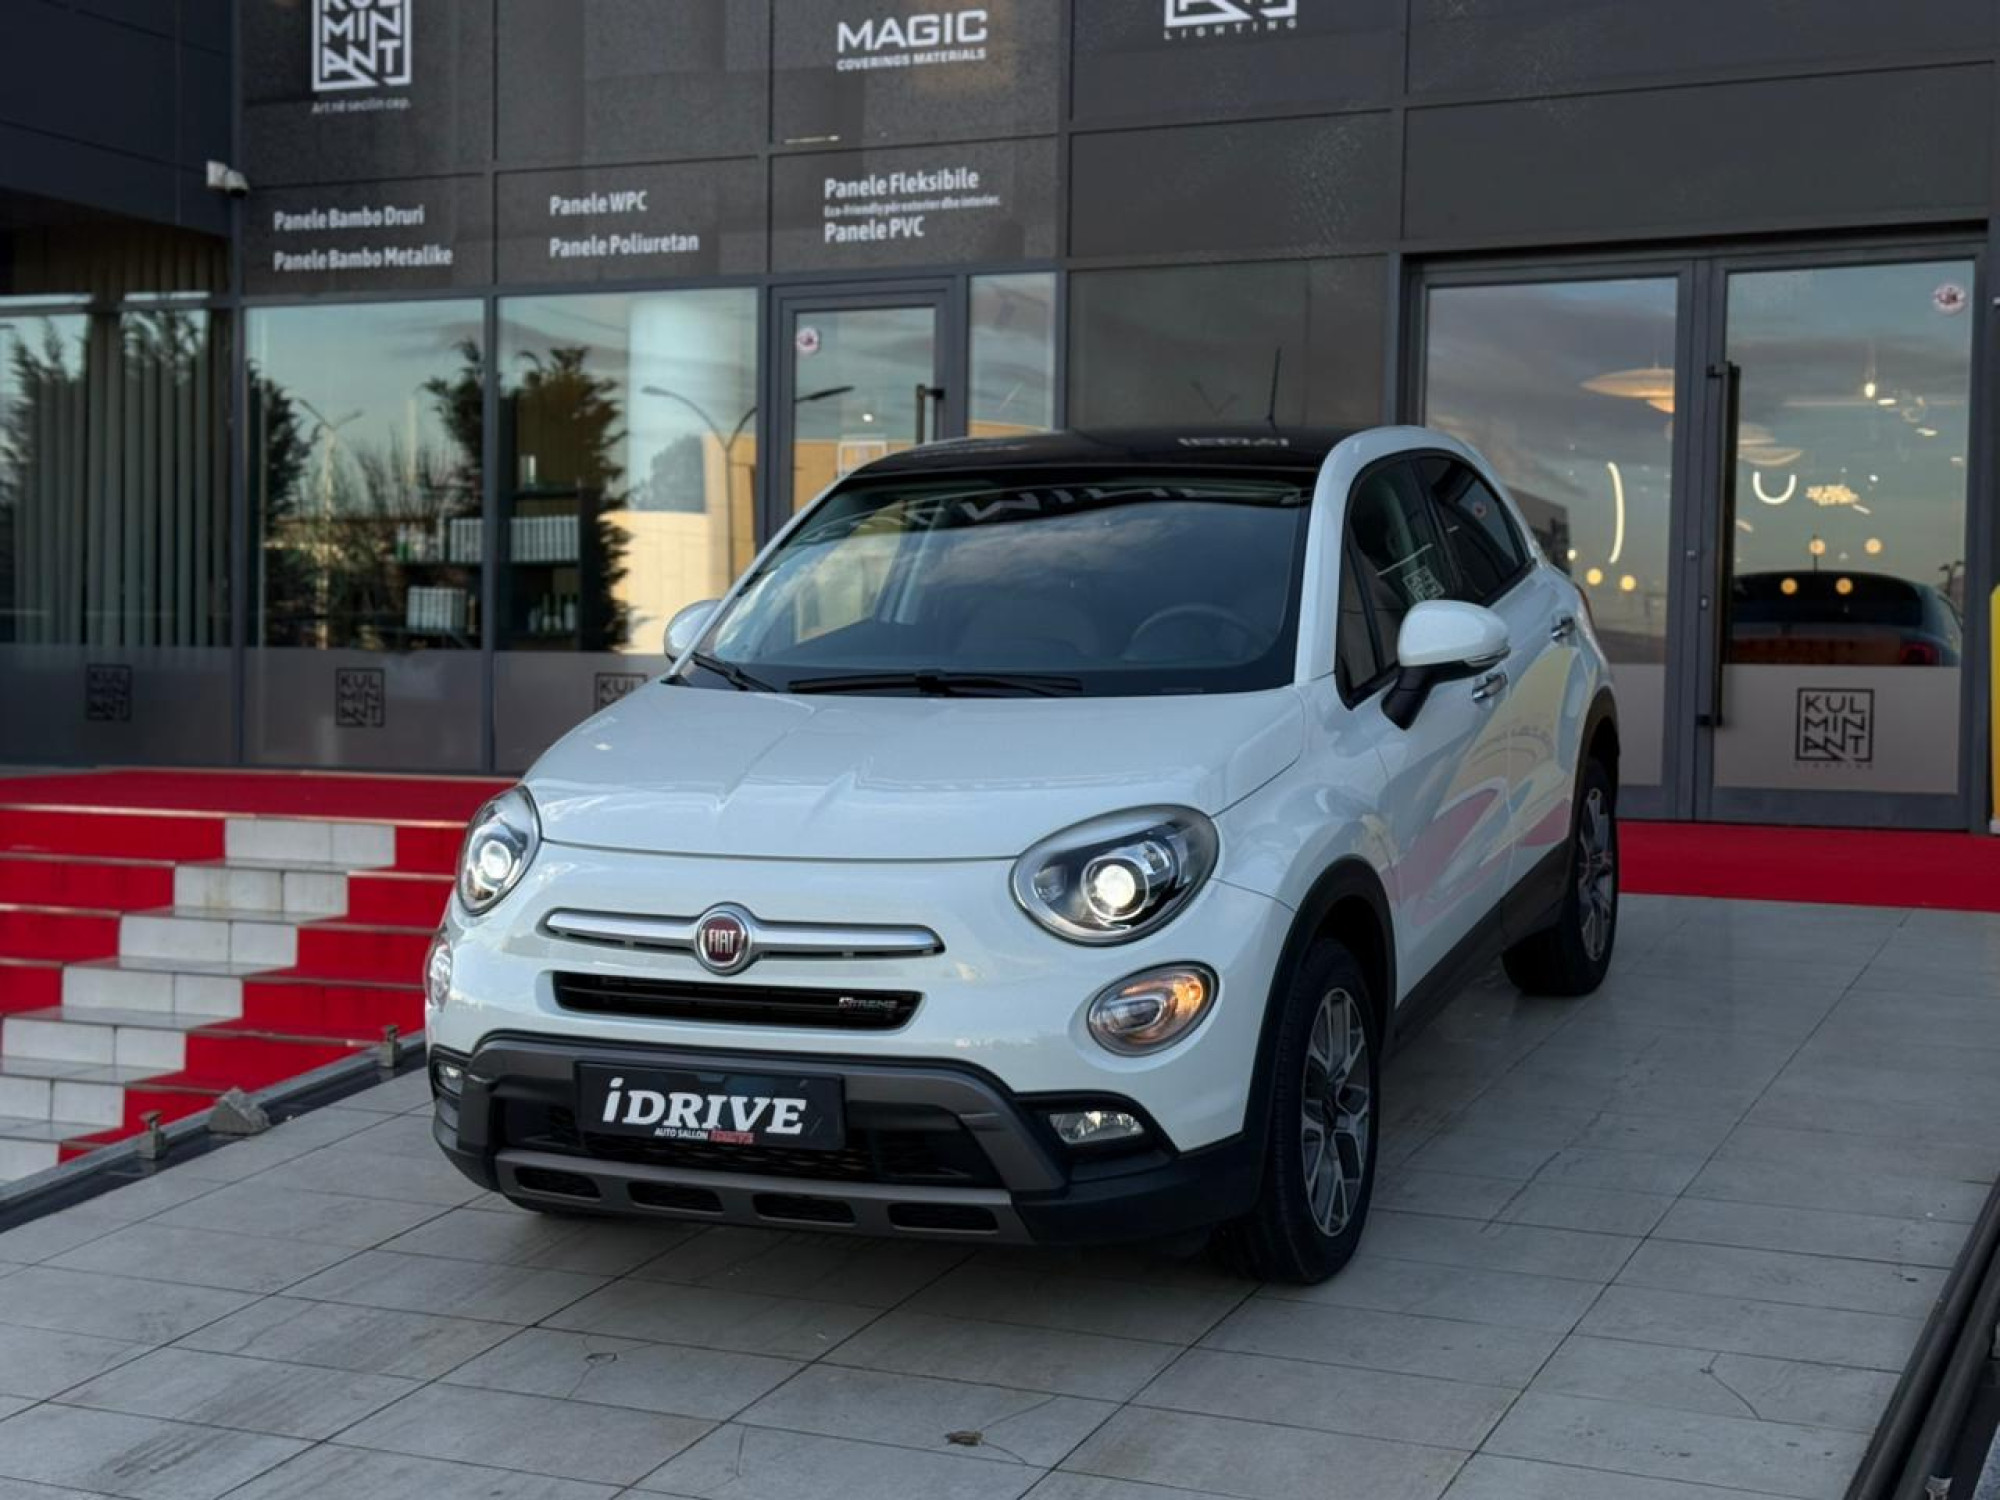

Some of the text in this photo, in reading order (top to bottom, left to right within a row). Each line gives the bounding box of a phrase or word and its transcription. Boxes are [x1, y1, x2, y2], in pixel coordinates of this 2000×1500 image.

[837, 10, 988, 53] MAGIC
[913, 47, 987, 65] MATERIALS
[824, 166, 980, 200] Panele Fleksibile
[550, 190, 648, 216] Panele WPC
[273, 204, 425, 231] Panele Bambo Druri
[824, 215, 925, 244] Panele PVC
[273, 244, 453, 272] Panele Bambo Metalike
[550, 232, 700, 258] Panele Poliuretan
[707, 928, 737, 954] FIAT
[602, 1077, 807, 1135] iDRIVE
[654, 1127, 676, 1138] AUTO
[677, 1128, 708, 1141] SALLON
